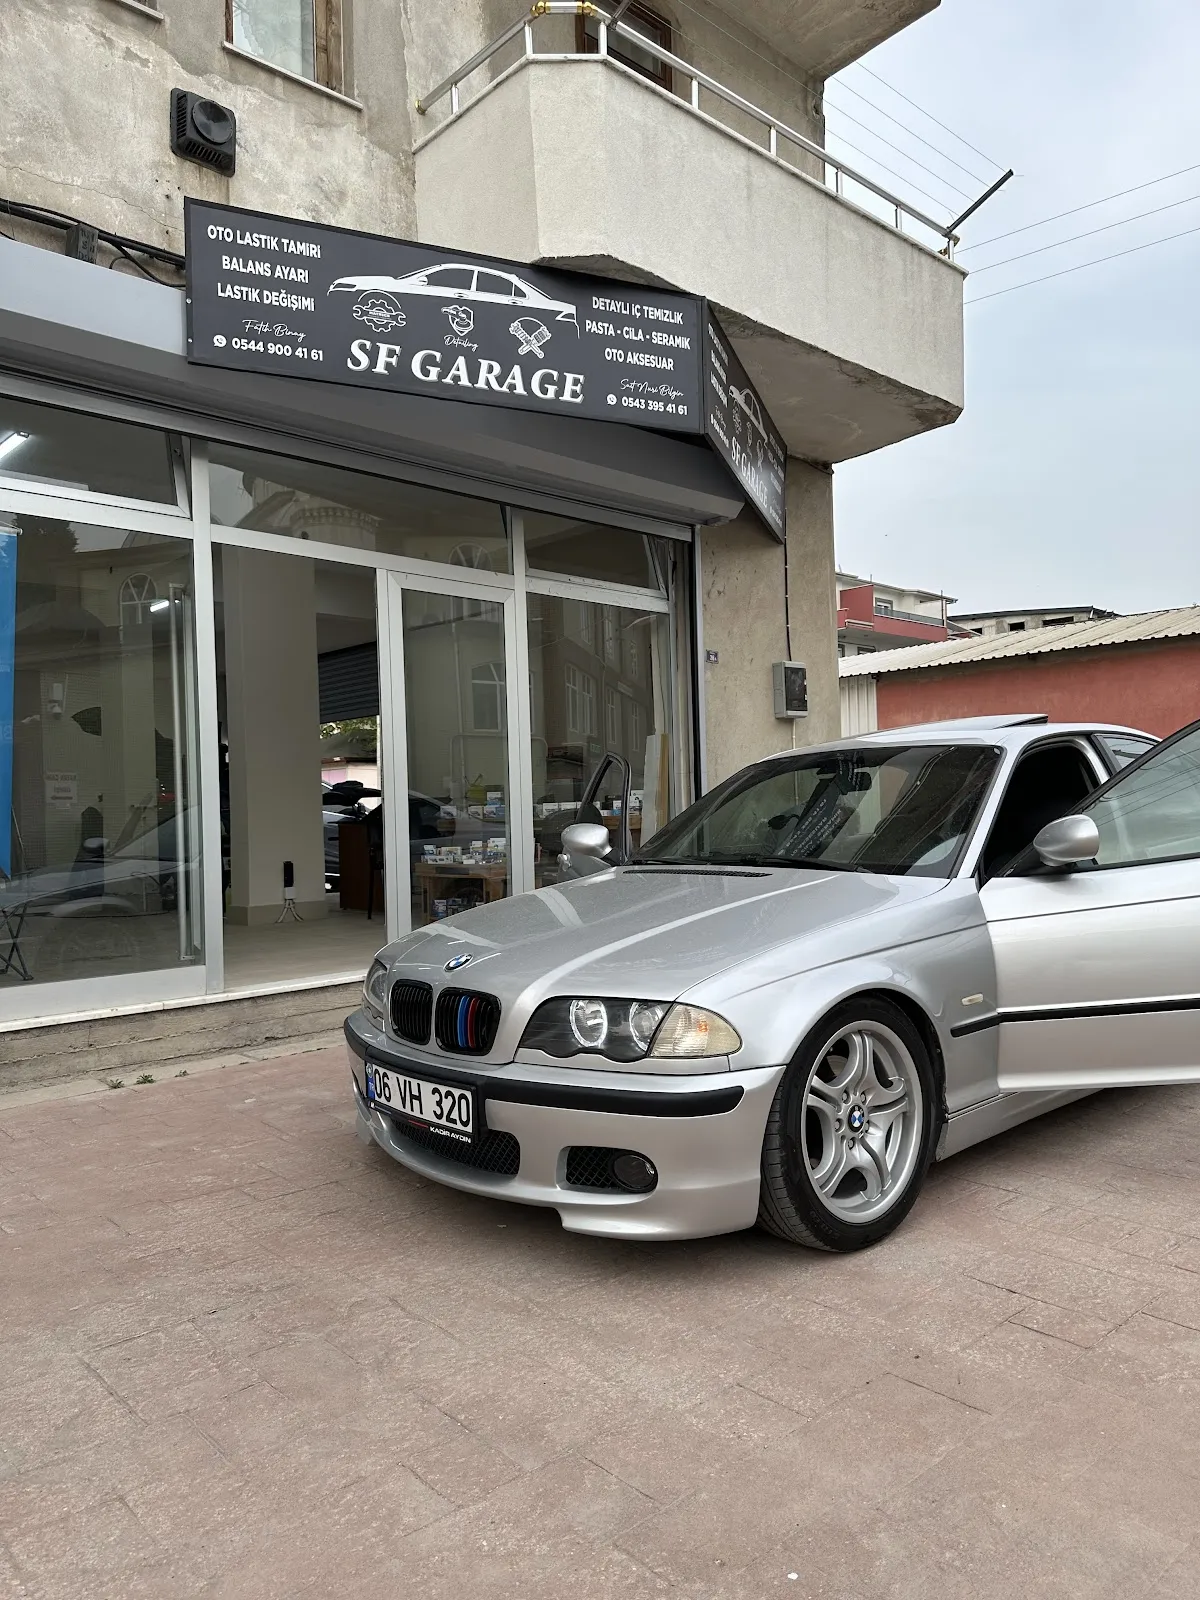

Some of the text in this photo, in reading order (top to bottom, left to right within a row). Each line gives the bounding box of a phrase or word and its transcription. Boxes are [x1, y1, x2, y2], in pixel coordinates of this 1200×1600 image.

[207, 225, 321, 259] OTO LASTİK TAMİRİ
[222, 255, 309, 283] BALANS AYARI
[217, 282, 260, 303] LASTİK
[592, 296, 629, 315] DETAYLI
[642, 305, 684, 325] TEMİZLİK
[242, 319, 272, 335] Fatih
[585, 319, 615, 337] PASTA
[622, 326, 645, 342] CİLA
[651, 331, 691, 350] SERAMİK
[231, 337, 323, 361] 0544 900 41 61
[443, 334, 479, 352] Detailing
[346, 338, 586, 404] SF GARAGE
[604, 347, 674, 371] OTO AKSESUAR
[621, 396, 688, 415] 0543 395 41 61
[731, 436, 768, 508] SF GARAGE
[374, 1068, 470, 1128] 06 VH 320
[450, 1132, 472, 1144] AYDIN
